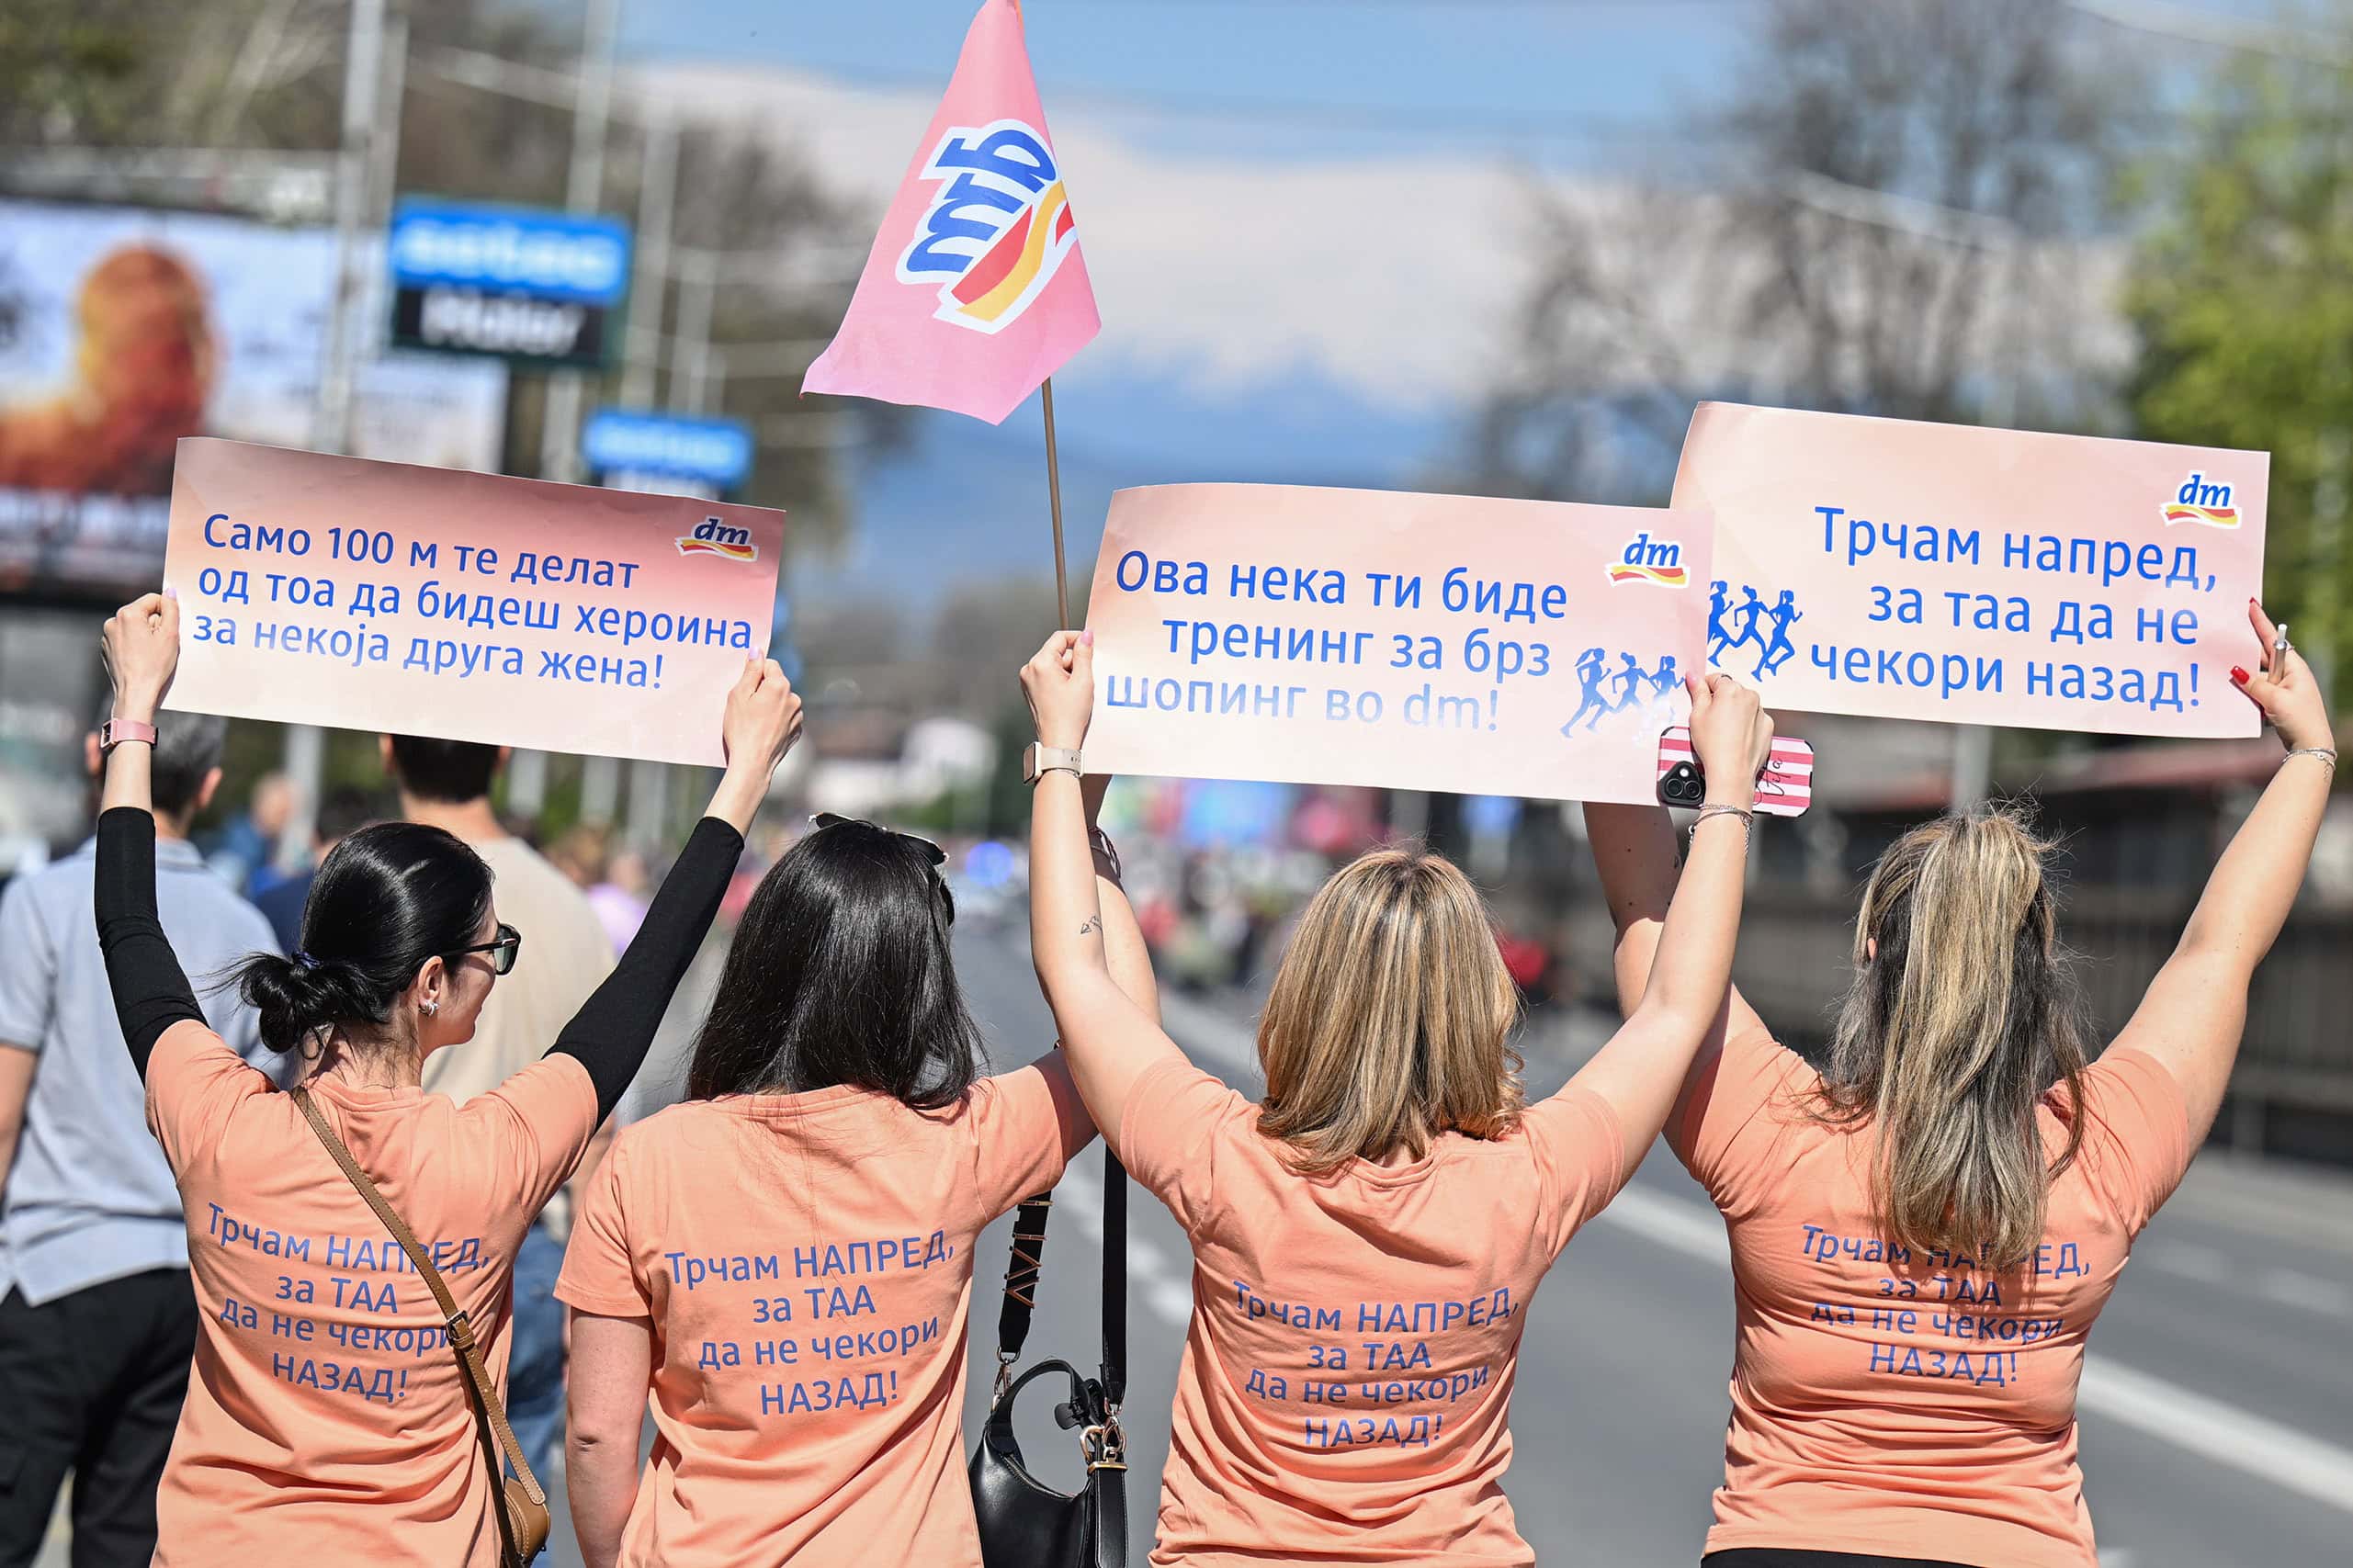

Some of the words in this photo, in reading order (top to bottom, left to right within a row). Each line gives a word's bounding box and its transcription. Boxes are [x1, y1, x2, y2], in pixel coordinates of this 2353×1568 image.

[2178, 474, 2231, 507] dm
[205, 514, 311, 556] Само
[329, 528, 394, 564] 100
[411, 542, 437, 569] м
[456, 547, 498, 575] те
[511, 553, 639, 588] делат
[694, 519, 751, 545] dm
[1624, 534, 1680, 566] dm
[1816, 507, 1979, 566] Трчам
[2004, 534, 2215, 592] напред,
[199, 569, 249, 604] од
[266, 574, 334, 607] тоа
[349, 584, 400, 617] да
[418, 581, 559, 629] бидеш
[574, 604, 752, 649] хероина
[1117, 551, 1208, 595] Ова
[1230, 565, 1345, 604] нека
[1367, 573, 1420, 608] ти
[1442, 567, 1567, 624] биде
[1869, 586, 1922, 623] за
[1944, 592, 2030, 632] таа
[2051, 602, 2112, 645] да
[2137, 608, 2198, 645] не
[194, 615, 235, 645] за
[255, 622, 389, 666] некоја
[403, 638, 523, 677] друга
[539, 651, 662, 688] жена!
[1163, 620, 1374, 664] тренинг
[1391, 635, 1442, 670] за
[1465, 628, 1549, 683] брз
[1812, 645, 2002, 699] чекори
[2028, 661, 2199, 713] назад!
[1107, 676, 1307, 716] шопинг
[1327, 690, 1382, 720] во
[1404, 682, 1498, 731] dm!
[209, 1202, 311, 1262] Трчам
[1803, 1224, 1911, 1264] Трчам
[665, 1252, 778, 1290] Трчам
[795, 1231, 954, 1278] НАПРЕД,
[276, 1276, 314, 1303] за
[331, 1278, 397, 1313] ТАА
[753, 1297, 792, 1323] за
[804, 1285, 876, 1319] ТАА
[1234, 1280, 1341, 1331] Трчам
[1358, 1287, 1518, 1333] НАПРЕД,
[1876, 1278, 1917, 1298] за
[1933, 1277, 2000, 1306] ТАА
[221, 1298, 257, 1329] да
[273, 1314, 314, 1341] не
[1812, 1303, 1855, 1326] да
[1873, 1308, 1917, 1335] не
[1933, 1314, 2064, 1343] чекори
[698, 1342, 741, 1371] да
[755, 1339, 798, 1364] не
[812, 1317, 938, 1359] чекори
[1308, 1345, 1347, 1370] за
[1363, 1342, 1431, 1370] ТАА
[1871, 1343, 2016, 1387] НАЗАД!
[274, 1352, 407, 1403] НАЗАД!
[761, 1371, 897, 1415] НАЗАД!
[1246, 1369, 1287, 1399] да
[1305, 1382, 1347, 1402] не
[1363, 1365, 1488, 1403] чекори
[1305, 1415, 1442, 1448] НАЗАД!
